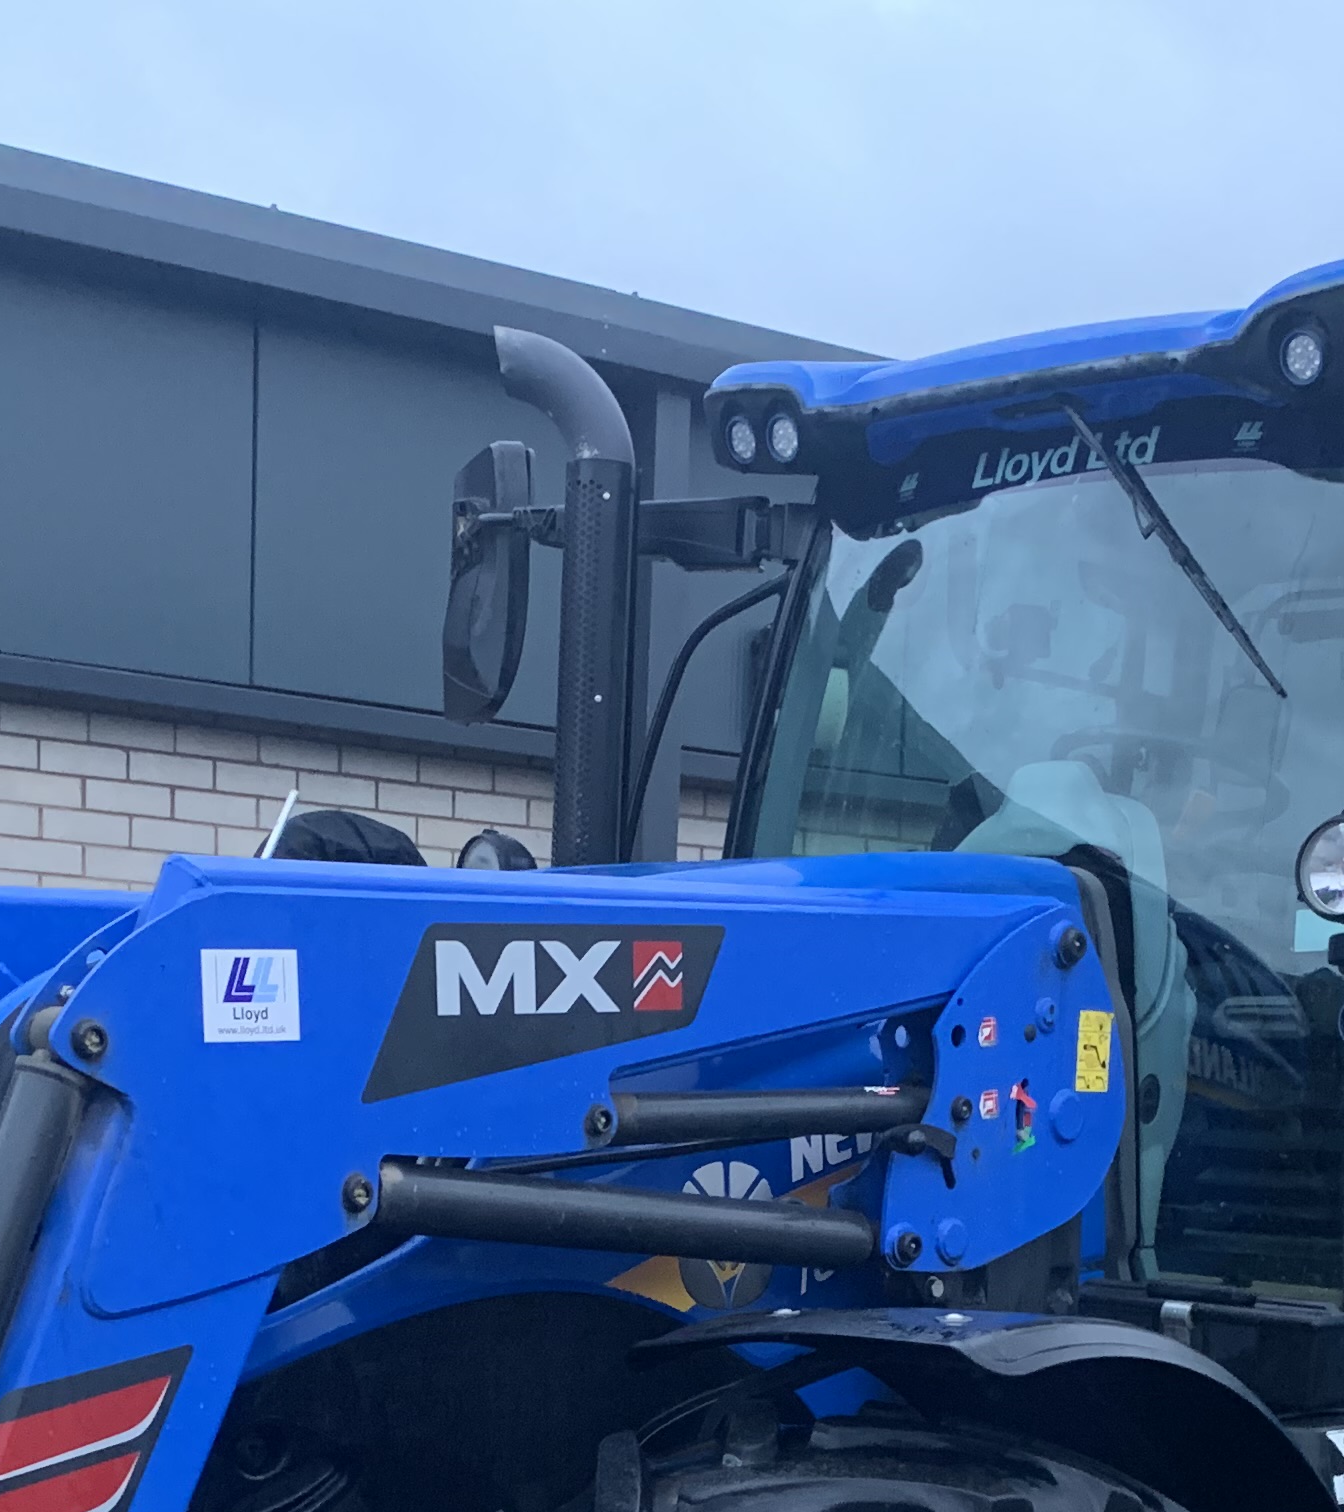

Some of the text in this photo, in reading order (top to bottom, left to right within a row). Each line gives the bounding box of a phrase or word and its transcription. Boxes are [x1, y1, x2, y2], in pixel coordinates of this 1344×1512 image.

[972, 426, 1160, 489] Lloyd Ltd
[435, 940, 622, 1016] MX
[233, 1006, 269, 1024] Lloyd
[790, 1132, 873, 1183] NE
